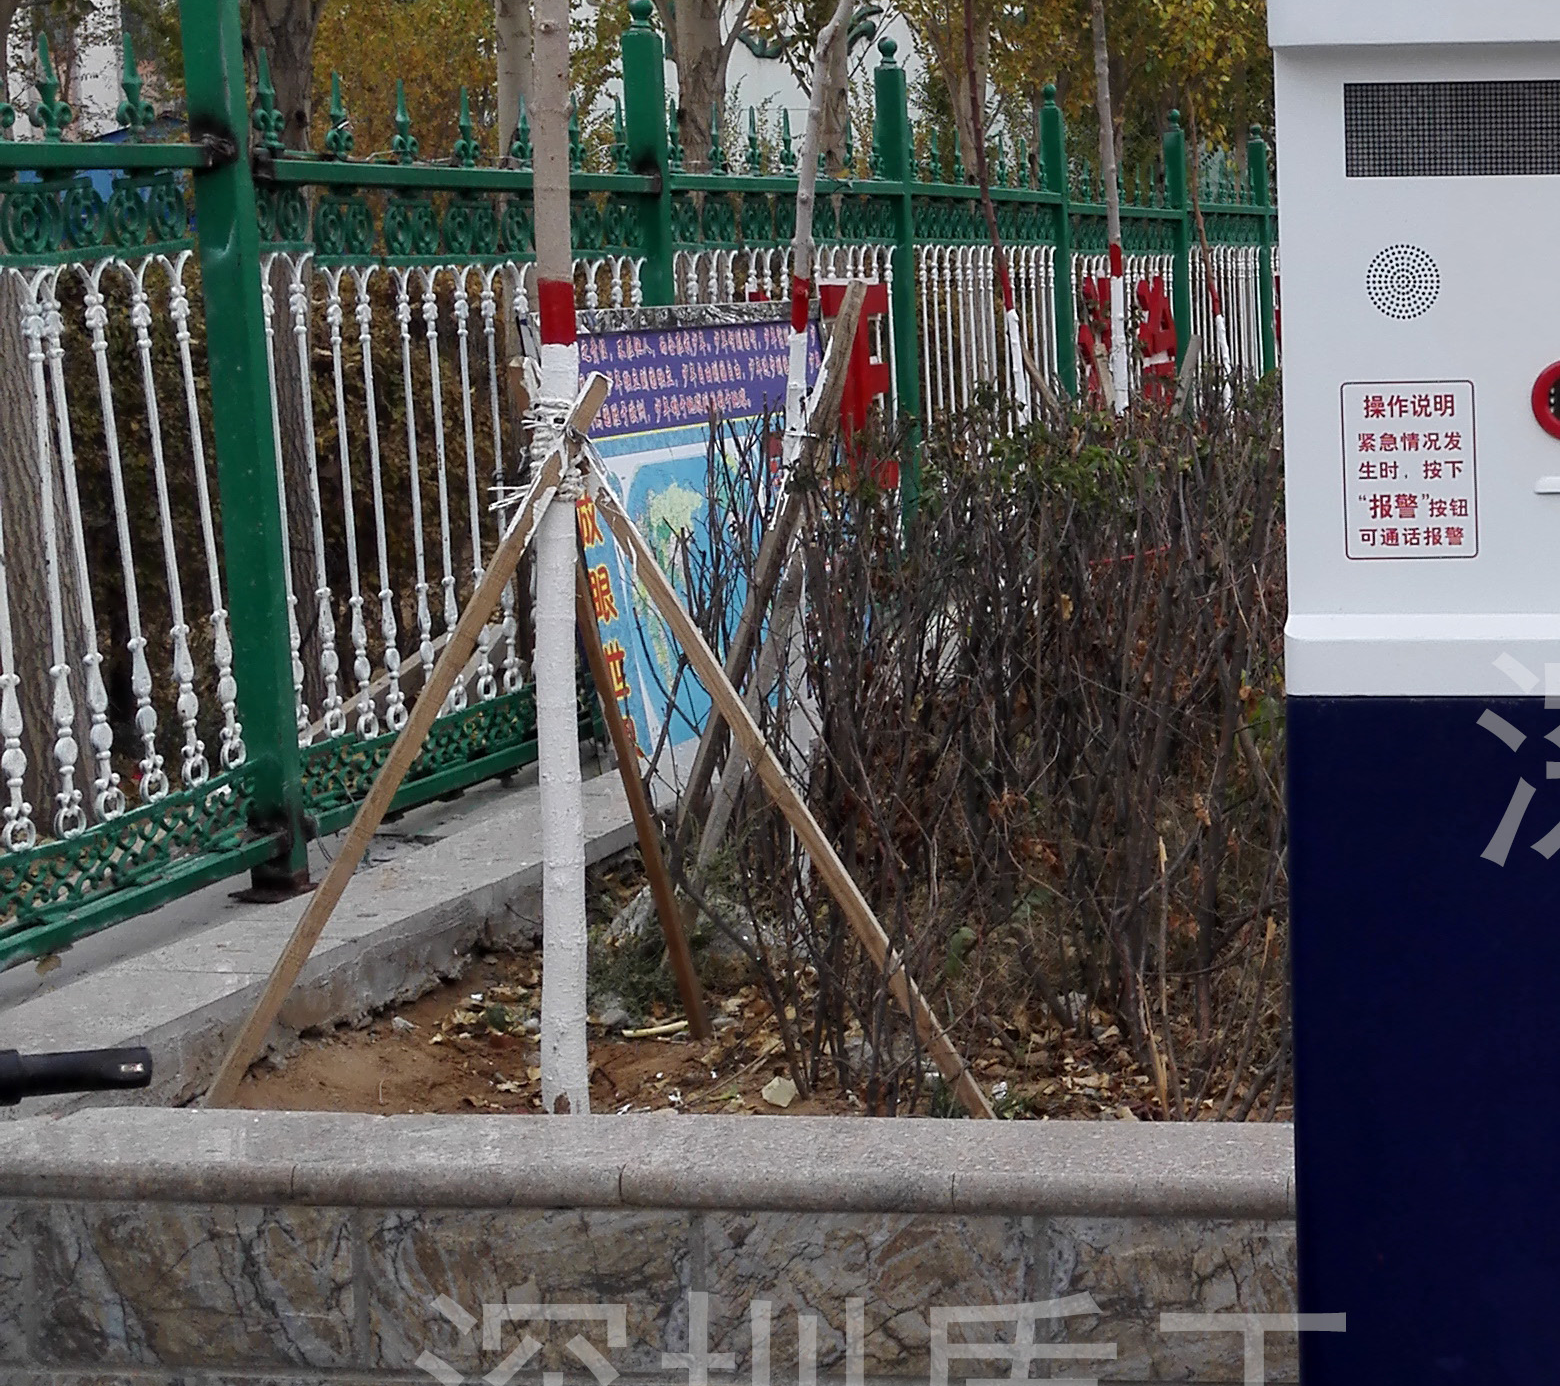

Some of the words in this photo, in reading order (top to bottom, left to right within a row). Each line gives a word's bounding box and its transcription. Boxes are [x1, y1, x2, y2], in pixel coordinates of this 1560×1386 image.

[1363, 394, 1456, 419] 操作说明
[1358, 431, 1462, 452] 紧急情况发
[1358, 526, 1465, 547] 可通话报警
